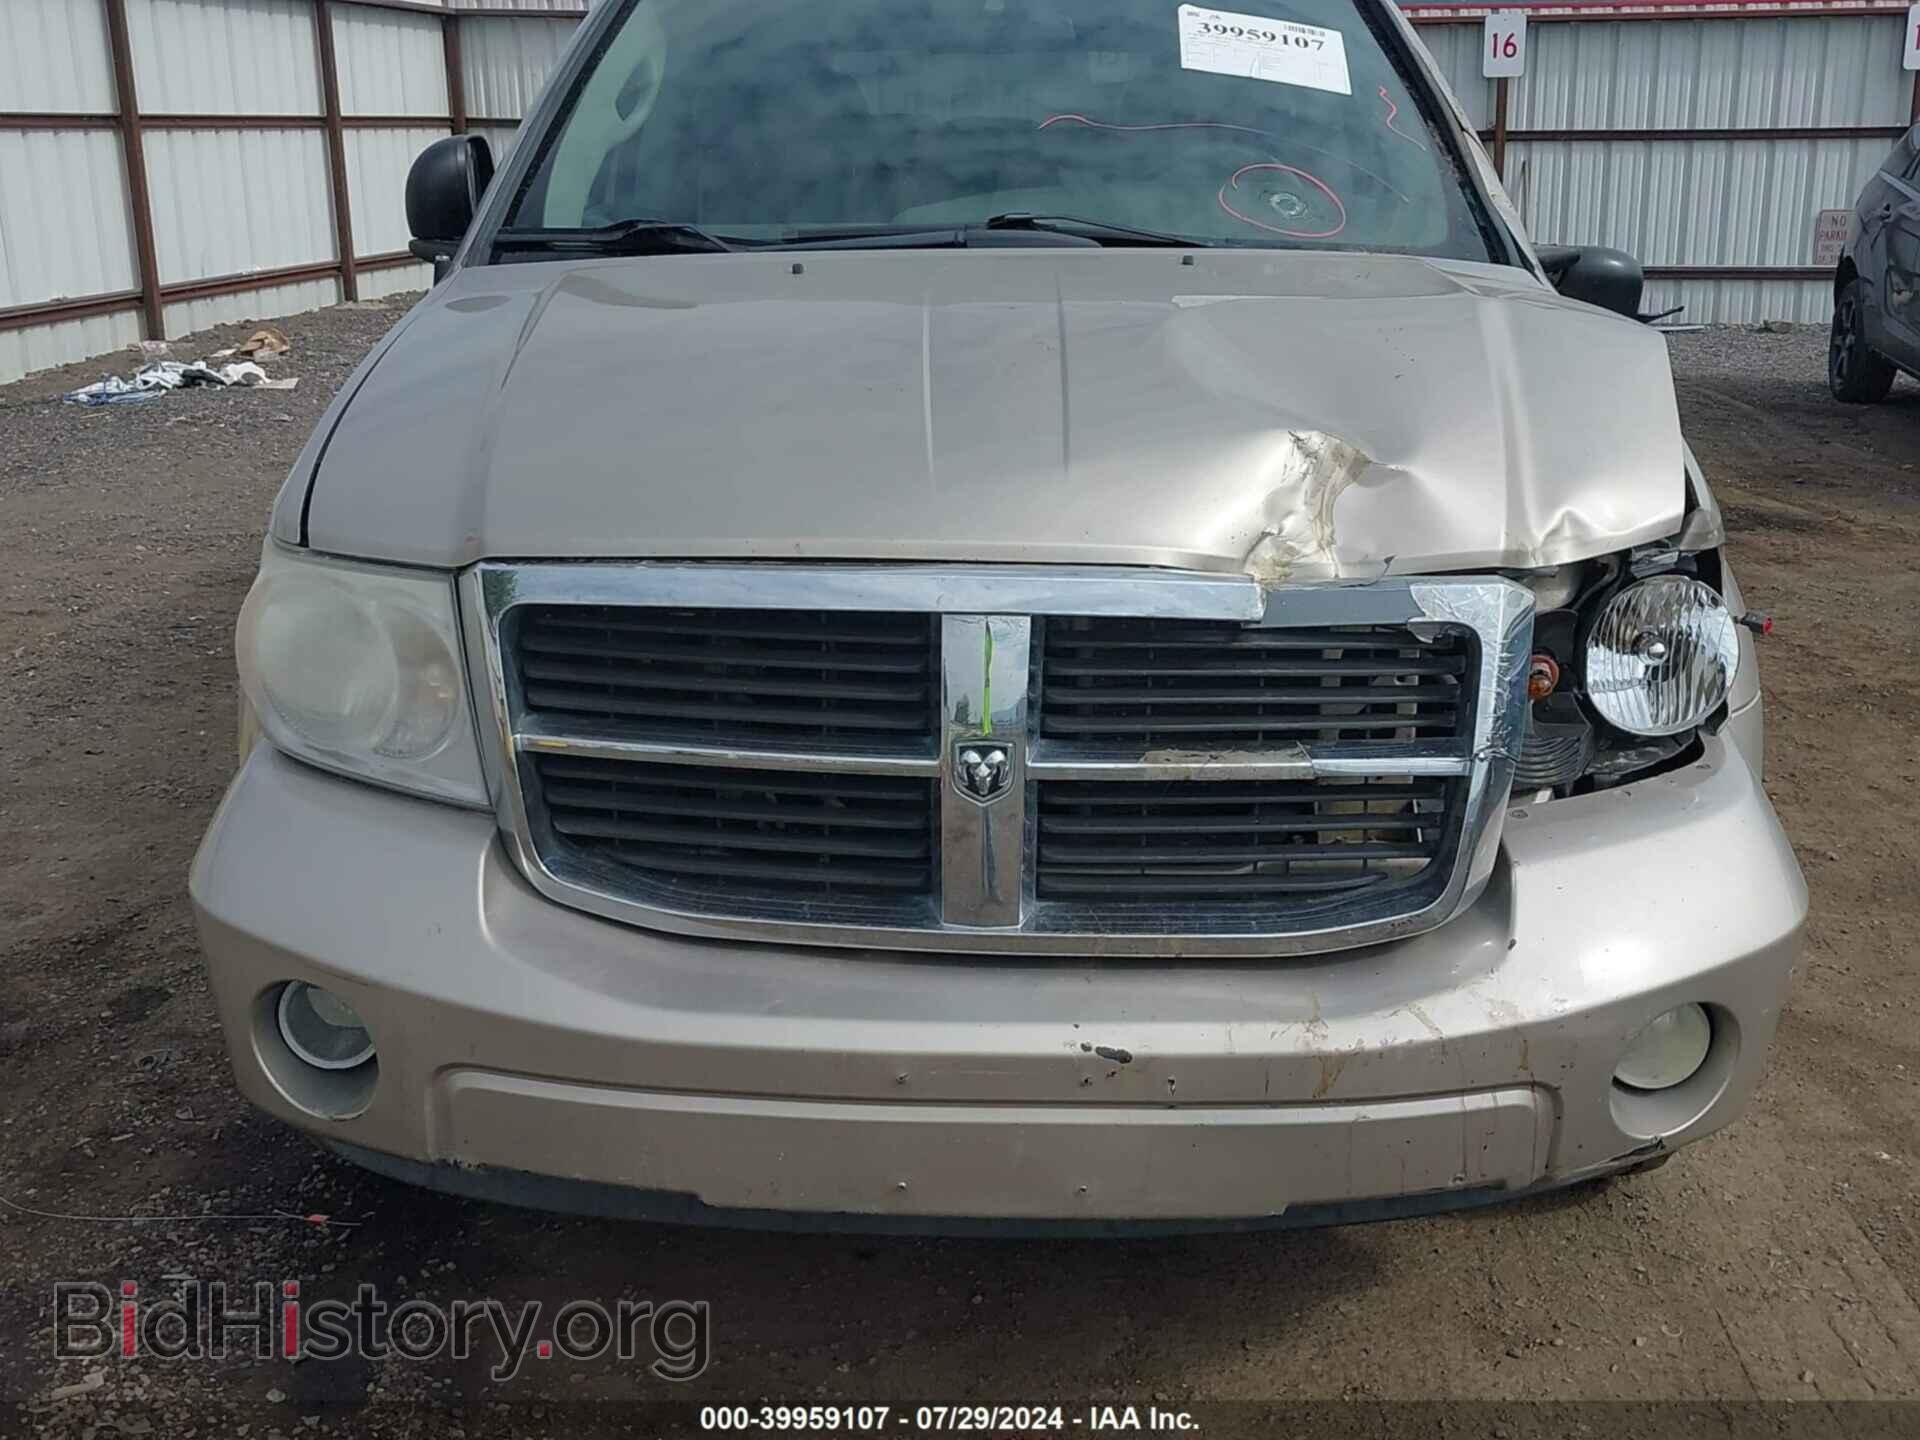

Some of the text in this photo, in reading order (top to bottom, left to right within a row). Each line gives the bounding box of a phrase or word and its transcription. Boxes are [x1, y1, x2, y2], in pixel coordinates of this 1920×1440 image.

[1197, 22, 1325, 51] 39959107
[1492, 32, 1517, 58] 16
[1831, 215, 1847, 227] NO
